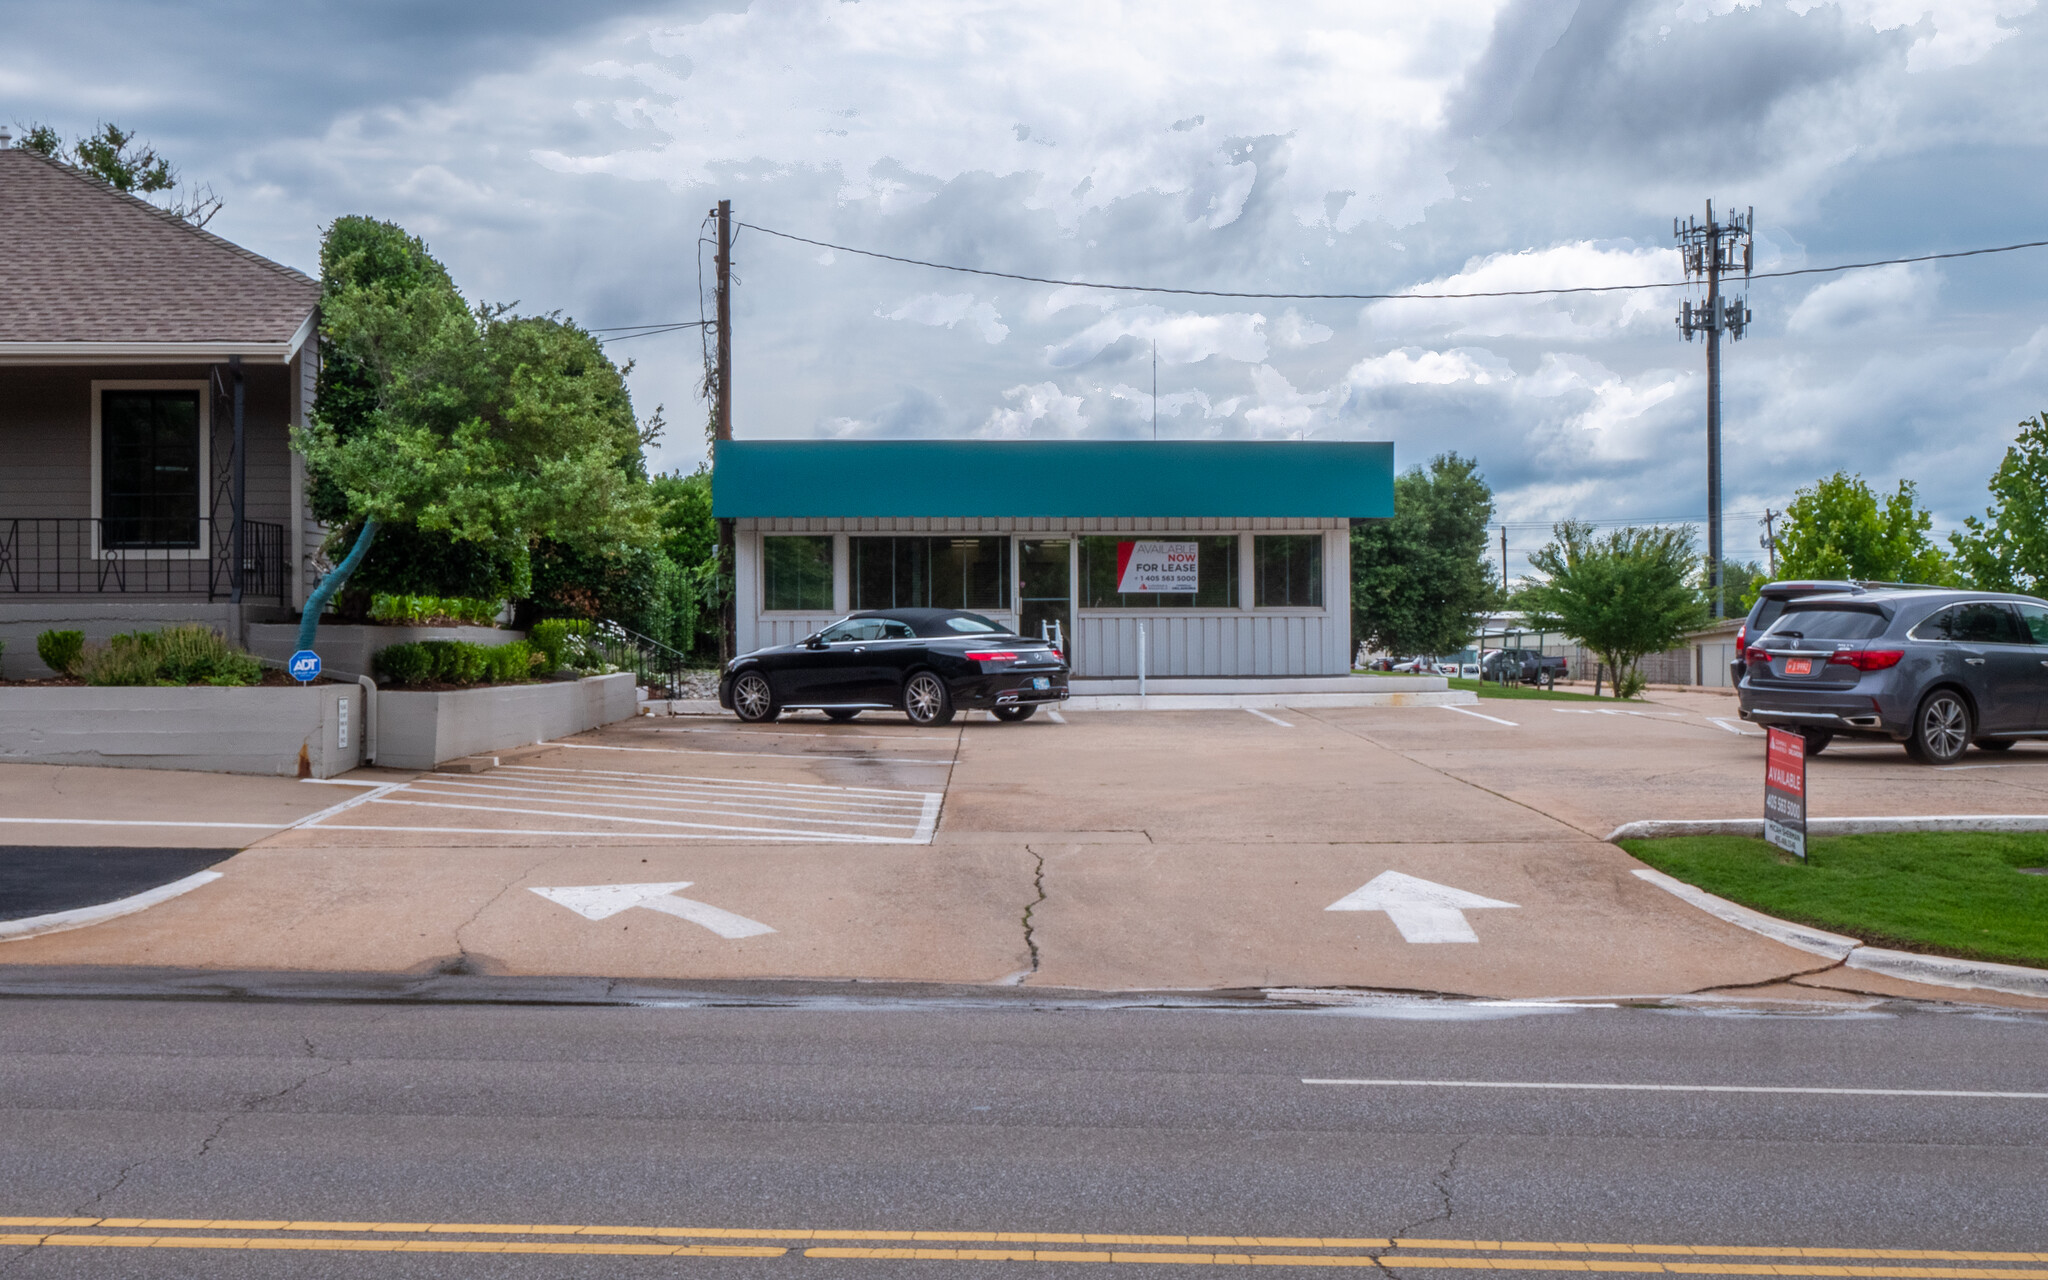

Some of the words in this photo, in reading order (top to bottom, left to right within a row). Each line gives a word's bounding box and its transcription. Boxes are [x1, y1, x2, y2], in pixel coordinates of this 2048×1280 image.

[1137, 544, 1196, 554] AVAILABLE
[1168, 554, 1196, 562] NOW
[1136, 564, 1158, 572] FOR
[1162, 564, 1196, 572] LEASE
[293, 658, 318, 671] ADT
[1768, 765, 1801, 790] AVAILABLE
[1766, 794, 1777, 811] 405
[1777, 797, 1787, 815] 563
[1787, 801, 1801, 819] 5000
